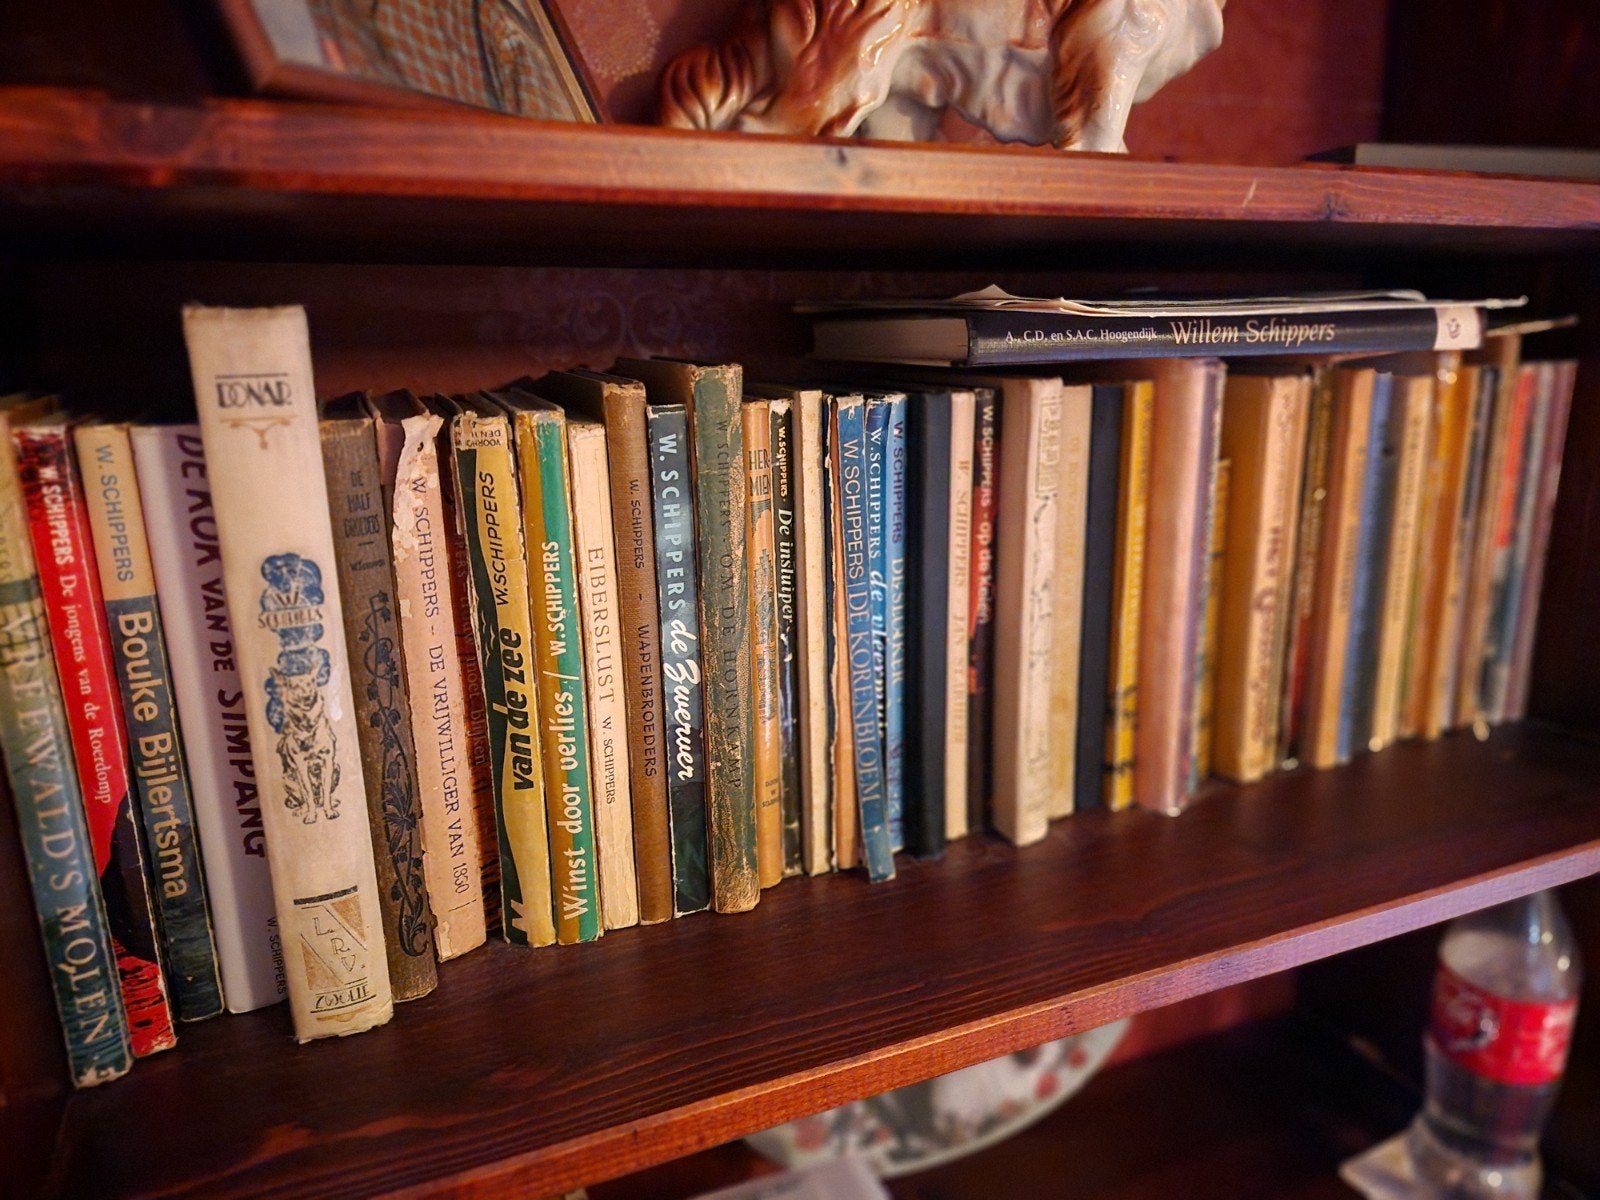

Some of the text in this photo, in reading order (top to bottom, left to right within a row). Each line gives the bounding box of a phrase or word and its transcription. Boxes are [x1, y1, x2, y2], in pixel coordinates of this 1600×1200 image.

[1023, 330, 1048, 342] C.D.
[1051, 331, 1064, 341] en
[1066, 329, 1098, 341] S.A.C.
[1100, 328, 1158, 343] Hoogendijk
[1170, 318, 1336, 347] Willem Schippers
[176, 433, 207, 478] DE
[658, 434, 677, 461] W.
[980, 427, 994, 507] SCHIPPERS
[42, 485, 74, 565] SCHIPPERS
[96, 444, 134, 582] W. SCHIPPERS
[778, 508, 793, 536] De
[844, 465, 864, 580] SCHIPPERS
[892, 447, 904, 544] SCHIPPERS
[415, 507, 440, 618] SCHIPPERS
[661, 470, 686, 611] SCHIPPERS
[978, 523, 992, 546] op
[979, 551, 992, 572] de
[59, 575, 77, 596] De
[720, 555, 733, 591] OM
[778, 541, 794, 626] insluiper
[869, 570, 887, 602] de
[62, 603, 86, 663] jongens
[201, 577, 229, 632] VAN
[588, 547, 615, 703] EIBERSLUST
[721, 606, 736, 636] DE
[849, 591, 869, 625] DE
[209, 640, 236, 673] DE
[429, 644, 445, 673] DE
[630, 499, 645, 569] SCHIPPERS
[638, 623, 657, 778] WAPENBROEDERS
[671, 620, 698, 654] de
[79, 668, 92, 695] van
[84, 703, 100, 720] de
[493, 626, 535, 792] van de zee
[433, 677, 461, 816] VRIJWILLIGER
[469, 708, 487, 765] blijken
[549, 691, 575, 771] verlies
[850, 632, 881, 802] KORENBLOEM
[88, 727, 112, 805] Roerdomp
[118, 610, 189, 899] Bouke Bijlertsma
[218, 690, 267, 858] SIMPANG
[600, 738, 616, 805] SCHIPPERS
[448, 818, 464, 859] VAN
[557, 785, 582, 835] door
[562, 845, 588, 922] Winst
[56, 904, 113, 1044] MOLEN
[268, 935, 287, 995] SCHIPPERS
